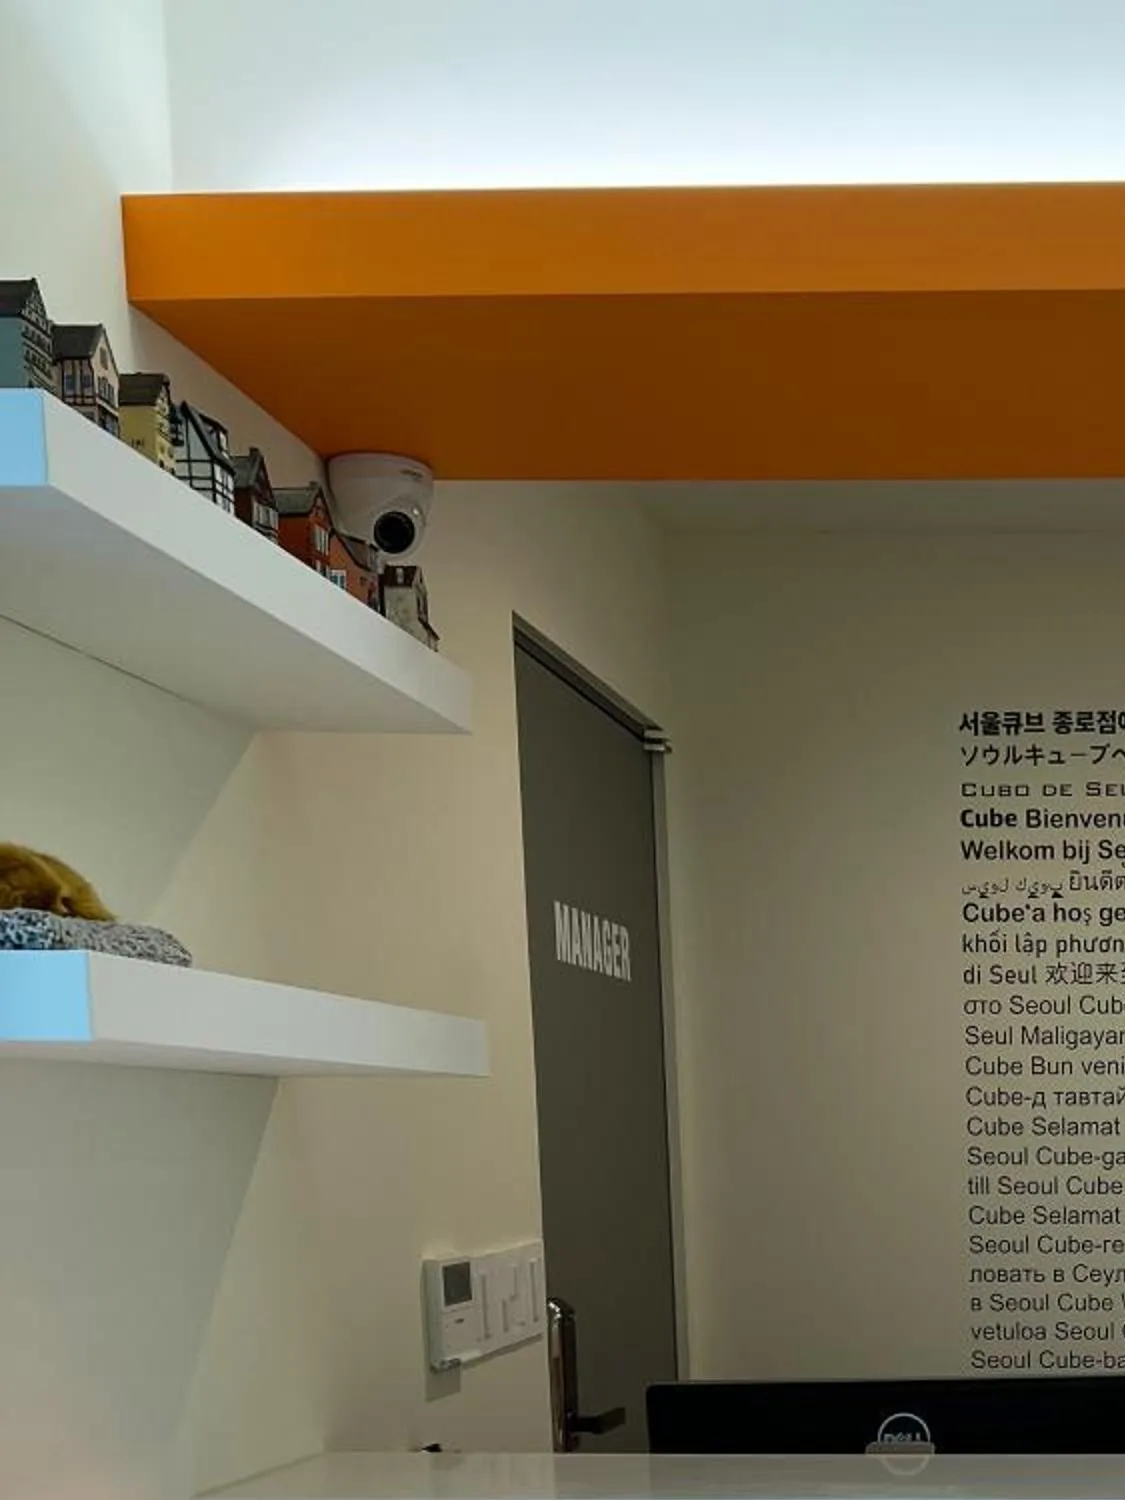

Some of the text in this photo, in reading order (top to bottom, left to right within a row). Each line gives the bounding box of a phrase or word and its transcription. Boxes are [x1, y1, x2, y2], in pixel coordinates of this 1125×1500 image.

[959, 711, 1045, 735] 서울큐브
[960, 808, 1017, 828] Cube
[960, 840, 1054, 861] Welkom
[1063, 840, 1090, 865] bij
[554, 900, 631, 981] MANAGER
[963, 964, 981, 984] di
[989, 964, 1037, 984] Seul
[1009, 994, 1071, 1015] Seoul
[965, 1025, 1012, 1046] Seul
[965, 1056, 1023, 1077] Cube
[1031, 1056, 1072, 1076] Bun
[967, 1115, 1024, 1136] Cube
[1032, 1116, 1120, 1136] Selamat
[968, 1146, 1028, 1166] Seoul
[968, 1176, 990, 1195] till
[998, 1176, 1058, 1195] Seoul
[1066, 1176, 1123, 1195] Cube
[969, 1205, 1025, 1225] Cube
[1033, 1205, 1120, 1225] Selamat
[970, 1234, 1029, 1254] Seoul
[969, 1267, 1045, 1283] ловать
[1053, 1268, 1064, 1283] в
[971, 1297, 982, 1312] в
[990, 1293, 1049, 1312] Seoul
[1058, 1293, 1114, 1312] Cube
[971, 1322, 1046, 1340] vetuloa
[1054, 1322, 1114, 1341] Seoul
[971, 1350, 1030, 1368] Seoul
